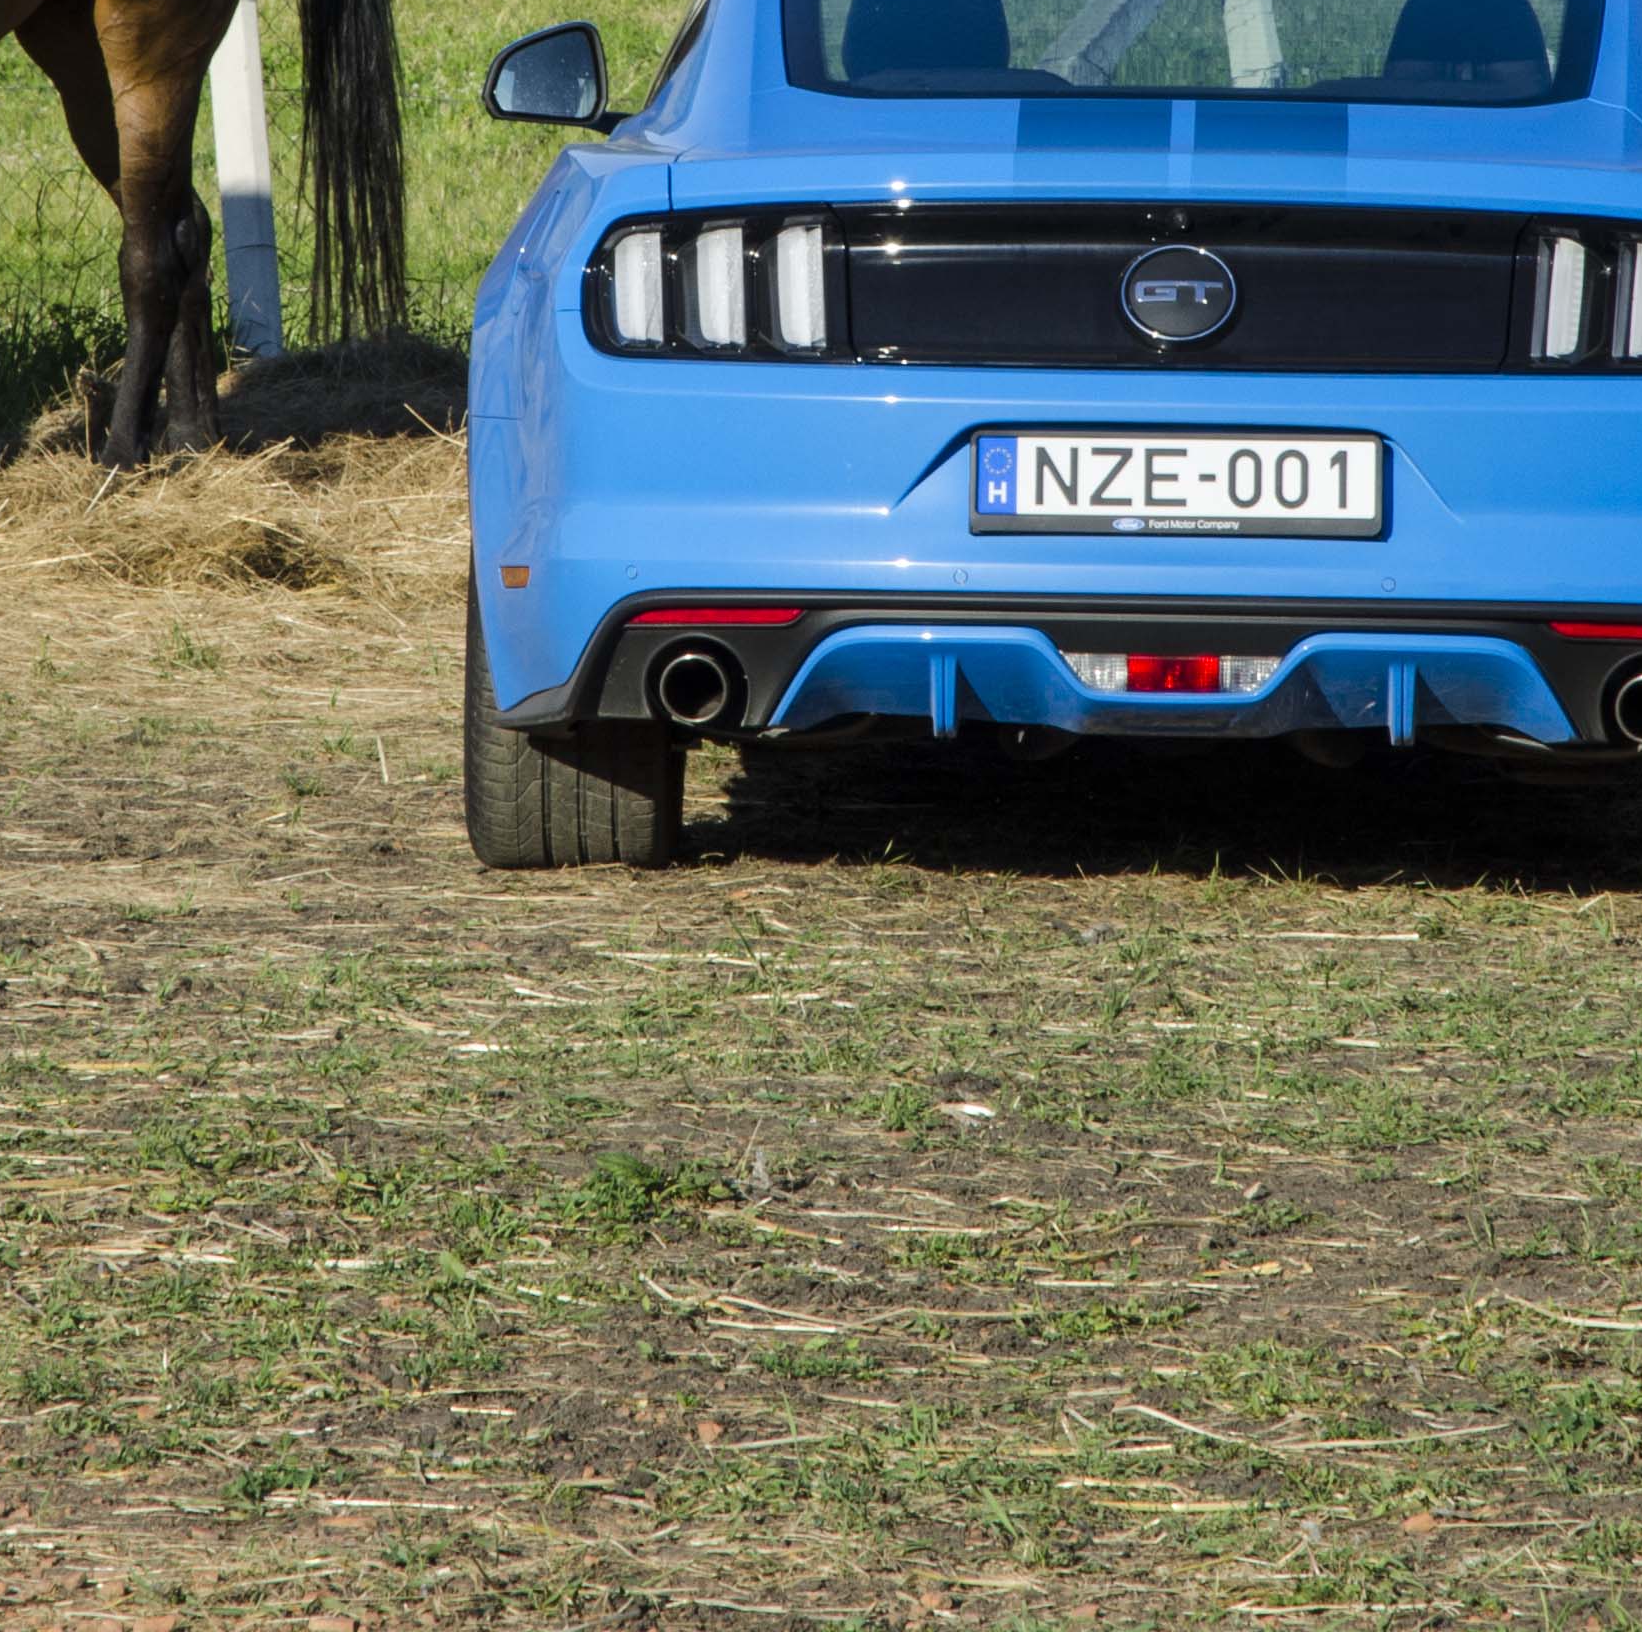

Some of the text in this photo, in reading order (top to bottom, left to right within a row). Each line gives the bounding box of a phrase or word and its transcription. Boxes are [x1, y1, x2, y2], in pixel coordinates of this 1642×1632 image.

[1135, 281, 1223, 303] GT
[1035, 447, 1347, 509] NZE-001
[988, 481, 1007, 504] H
[1148, 519, 1169, 529] Ford
[1170, 519, 1196, 529] Motor
[1197, 519, 1239, 530] Company
